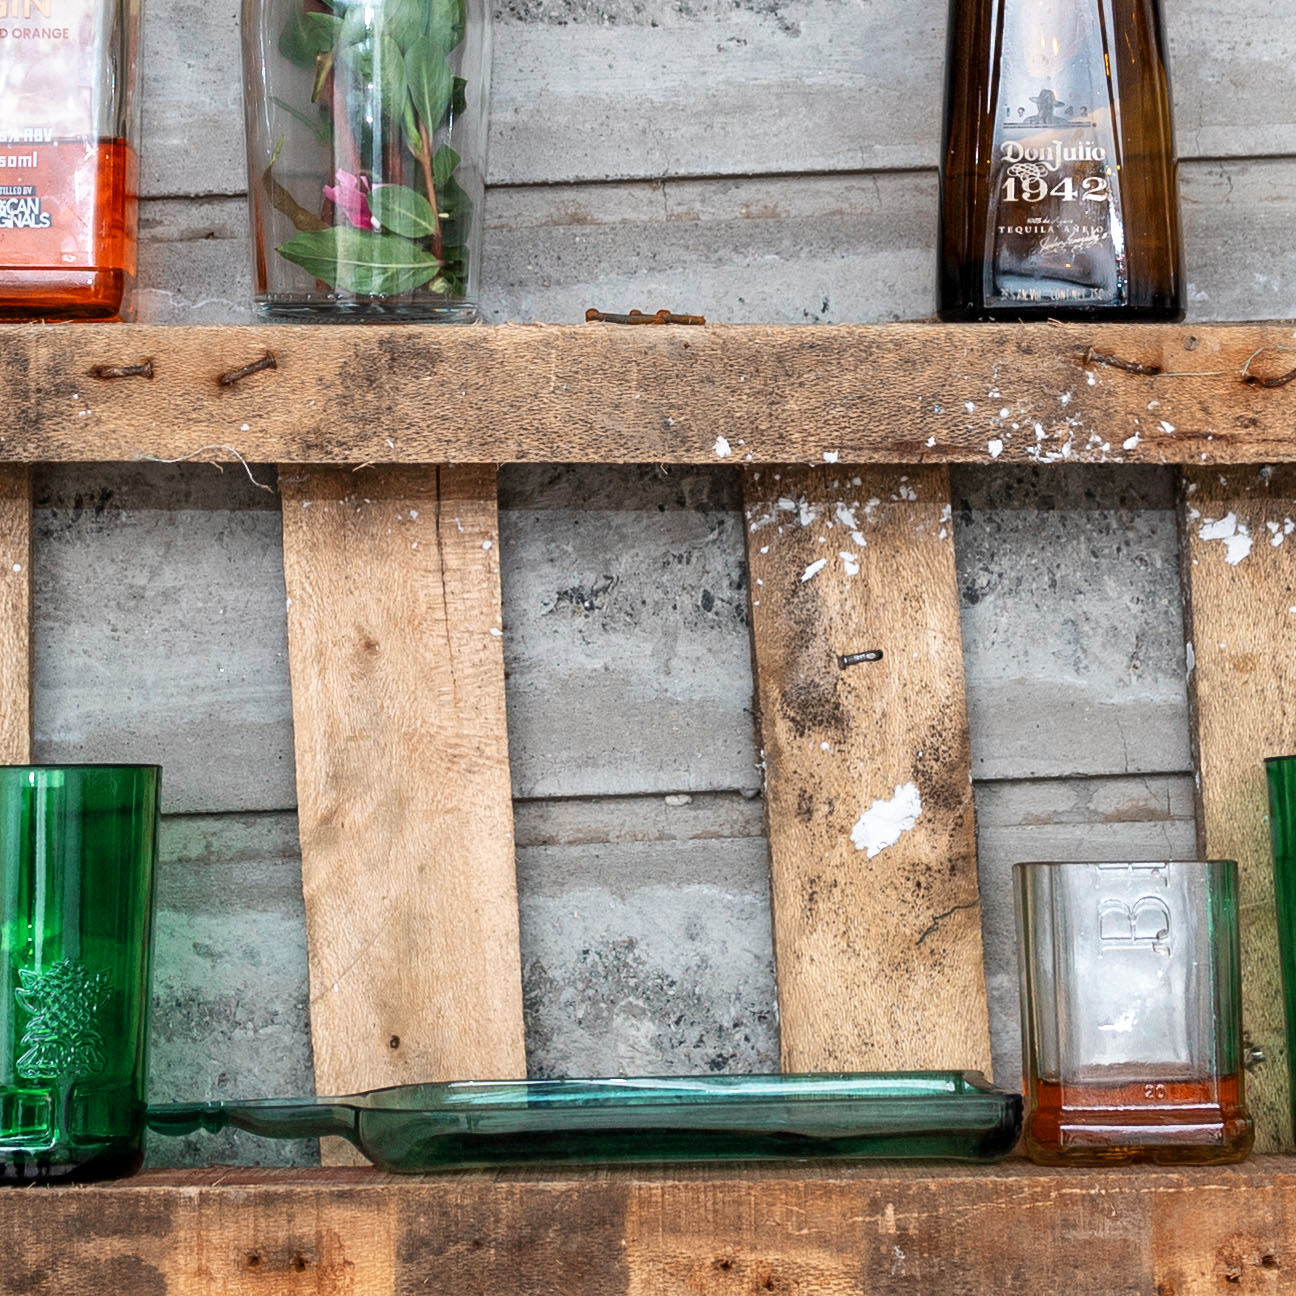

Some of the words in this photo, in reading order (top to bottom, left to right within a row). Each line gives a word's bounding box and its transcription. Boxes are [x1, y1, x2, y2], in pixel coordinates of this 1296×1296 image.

[11, 27, 70, 39] ORANGE
[23, 127, 54, 142] ABV
[22, 186, 33, 195] BY
[1001, 176, 1107, 203] 1942
[997, 225, 1055, 235] TEQUILA
